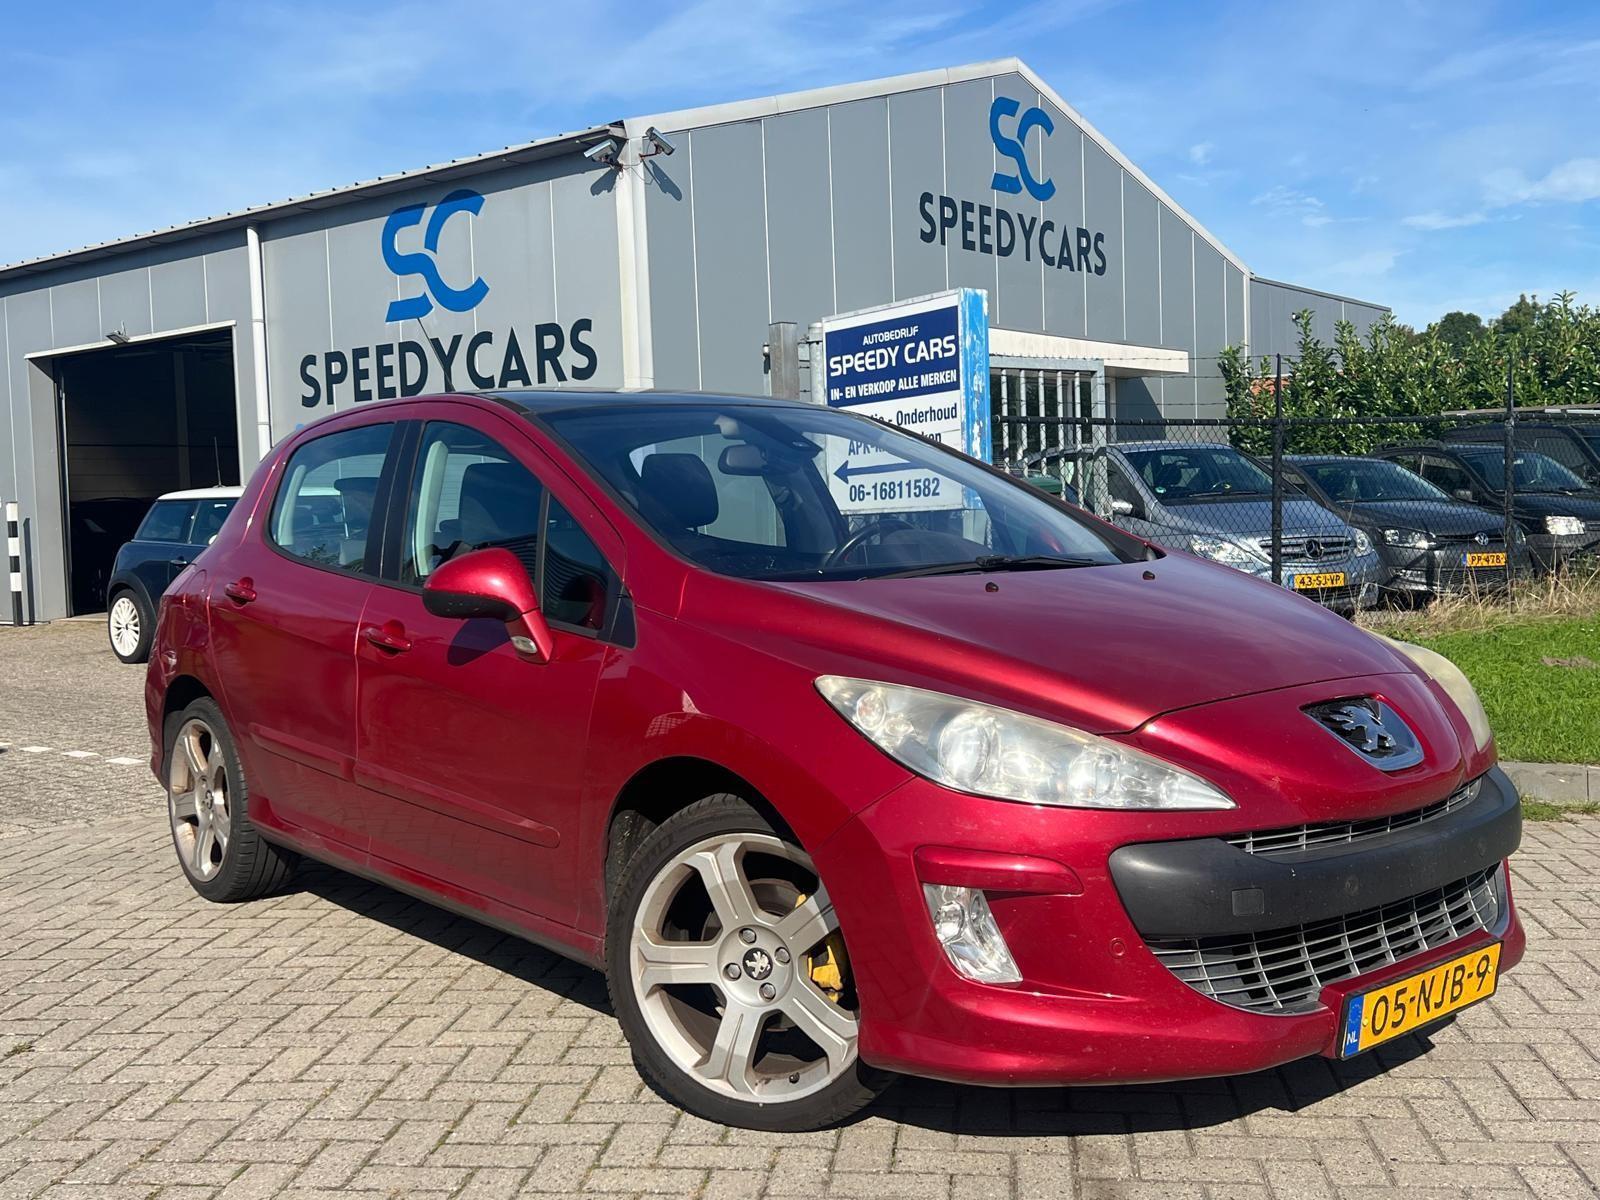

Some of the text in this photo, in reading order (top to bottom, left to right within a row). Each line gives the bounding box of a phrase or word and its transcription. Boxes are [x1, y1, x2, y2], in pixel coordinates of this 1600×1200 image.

[989, 96, 1056, 201] SC
[919, 191, 1107, 276] SPEEDYCARS
[381, 188, 490, 323] SC
[862, 325, 919, 346] AUTOBEDRIJF
[299, 318, 598, 408] SPEEDYCARS
[829, 335, 957, 377] SPEEDY CARS
[830, 369, 957, 401] IN- EN VERKOOP ALLE MERKEN
[896, 403, 958, 426] Onderhoud
[849, 477, 941, 502] 06-16811582
[1471, 554, 1507, 566] PP-478-
[1299, 574, 1341, 587] 43-SJ-VP
[1346, 954, 1490, 1046] NL 05-NJB-9
